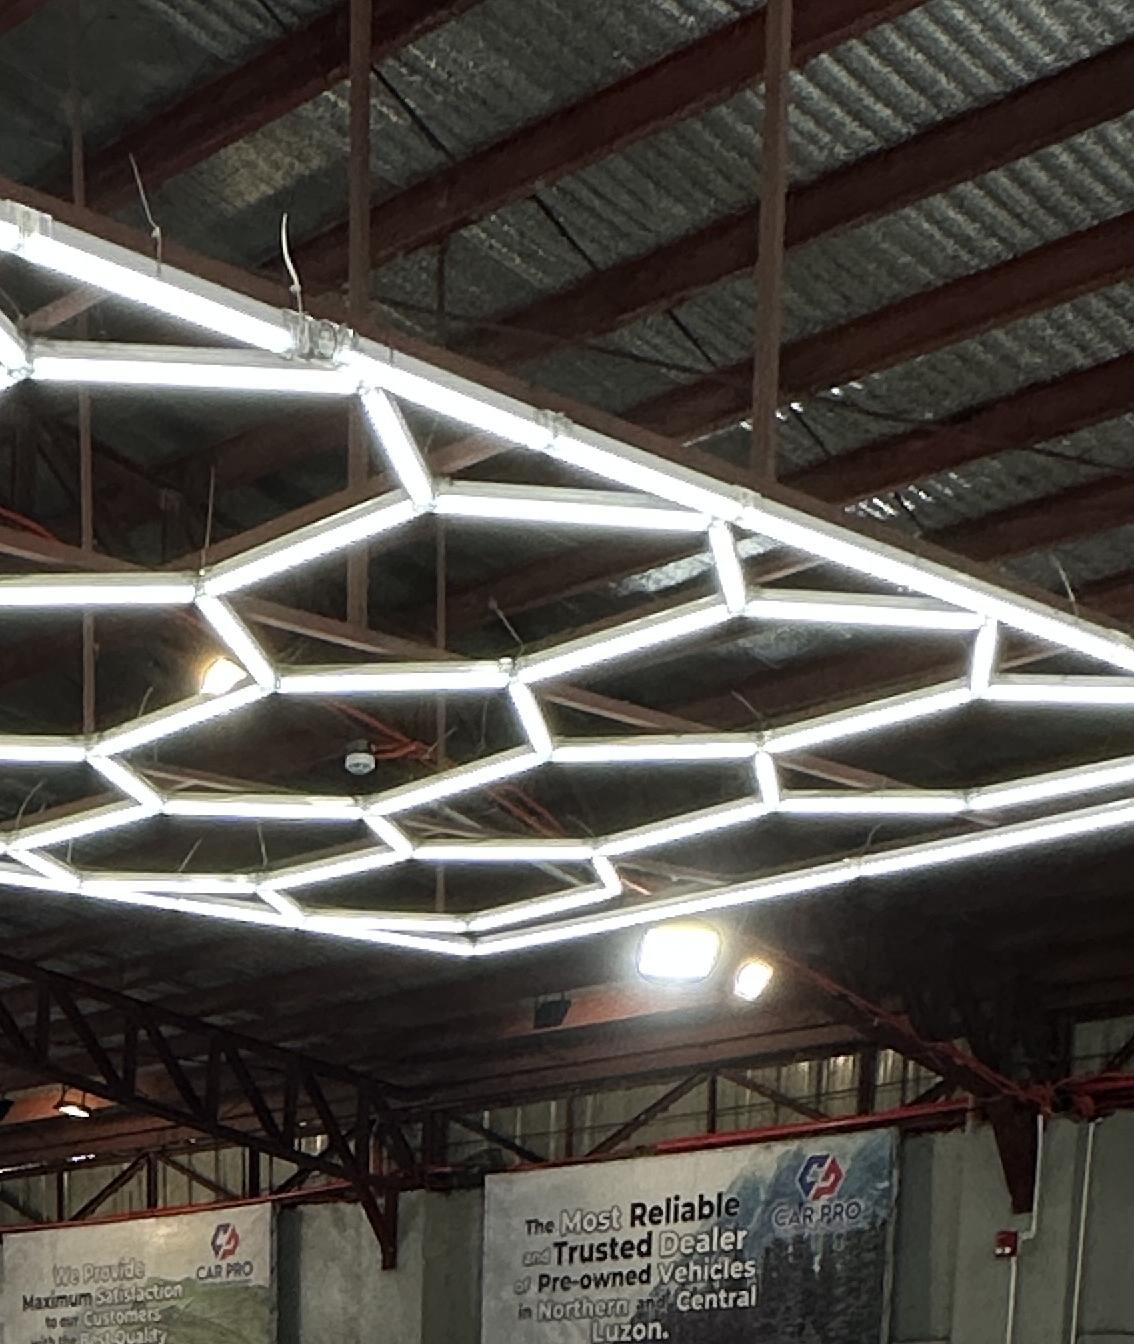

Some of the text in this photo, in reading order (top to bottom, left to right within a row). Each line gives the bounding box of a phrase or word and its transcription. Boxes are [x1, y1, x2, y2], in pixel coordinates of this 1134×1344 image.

[525, 1192, 740, 1236] The Most Reliable
[774, 1201, 862, 1227] CAR PRO
[553, 1231, 653, 1265] Trusted
[658, 1227, 748, 1257] Dealer
[82, 1258, 146, 1285] Provide
[196, 1261, 254, 1281] CAR PRO
[538, 1265, 652, 1293] Pre-owned
[657, 1258, 756, 1284] Vehicles
[22, 1282, 185, 1312] Maximum Satisfaction
[518, 1303, 531, 1319] in
[536, 1297, 629, 1322] Northern
[676, 1285, 758, 1312] Central
[83, 1307, 162, 1328] Customers
[590, 1321, 670, 1344] Luzon.
